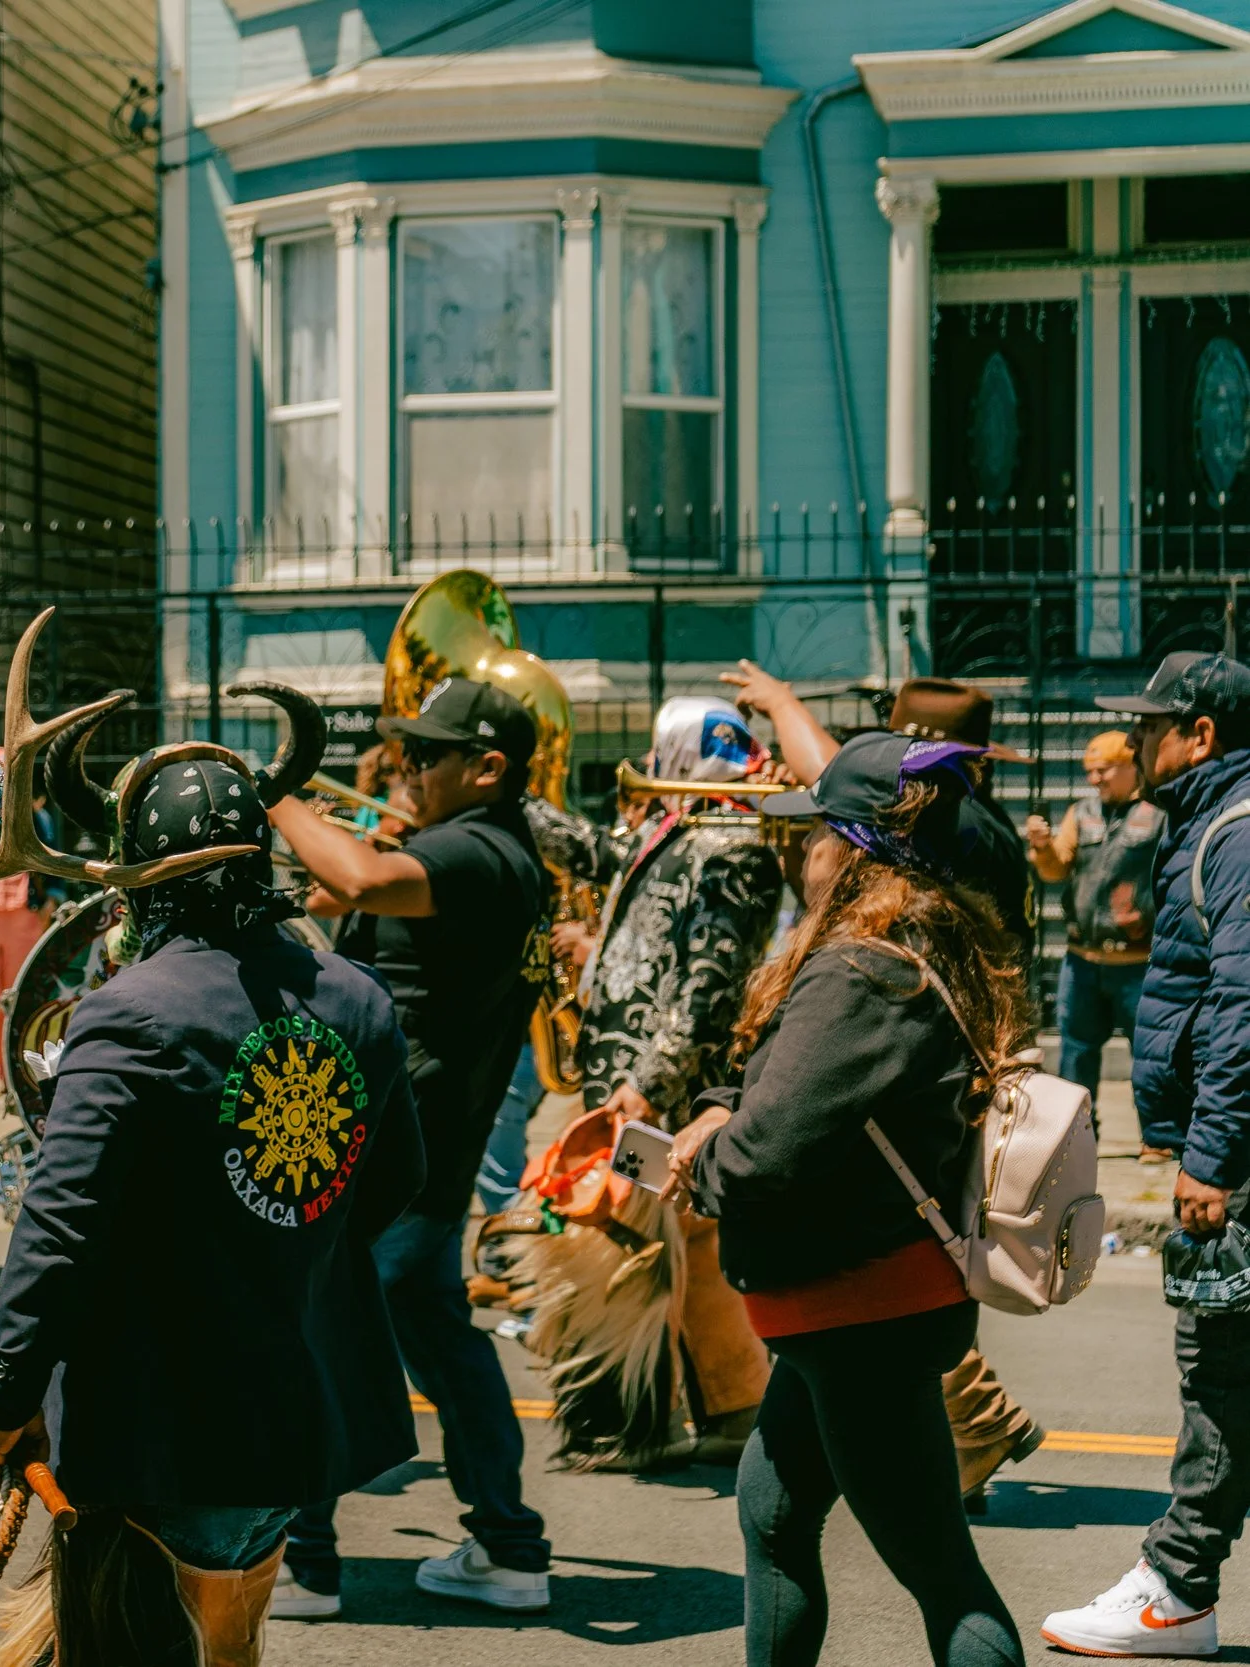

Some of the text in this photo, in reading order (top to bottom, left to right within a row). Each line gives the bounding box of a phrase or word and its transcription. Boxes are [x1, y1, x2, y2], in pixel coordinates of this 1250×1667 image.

[310, 1018, 368, 1110] UNIDOS
[224, 1124, 365, 1227] OAXACA MEXICO
